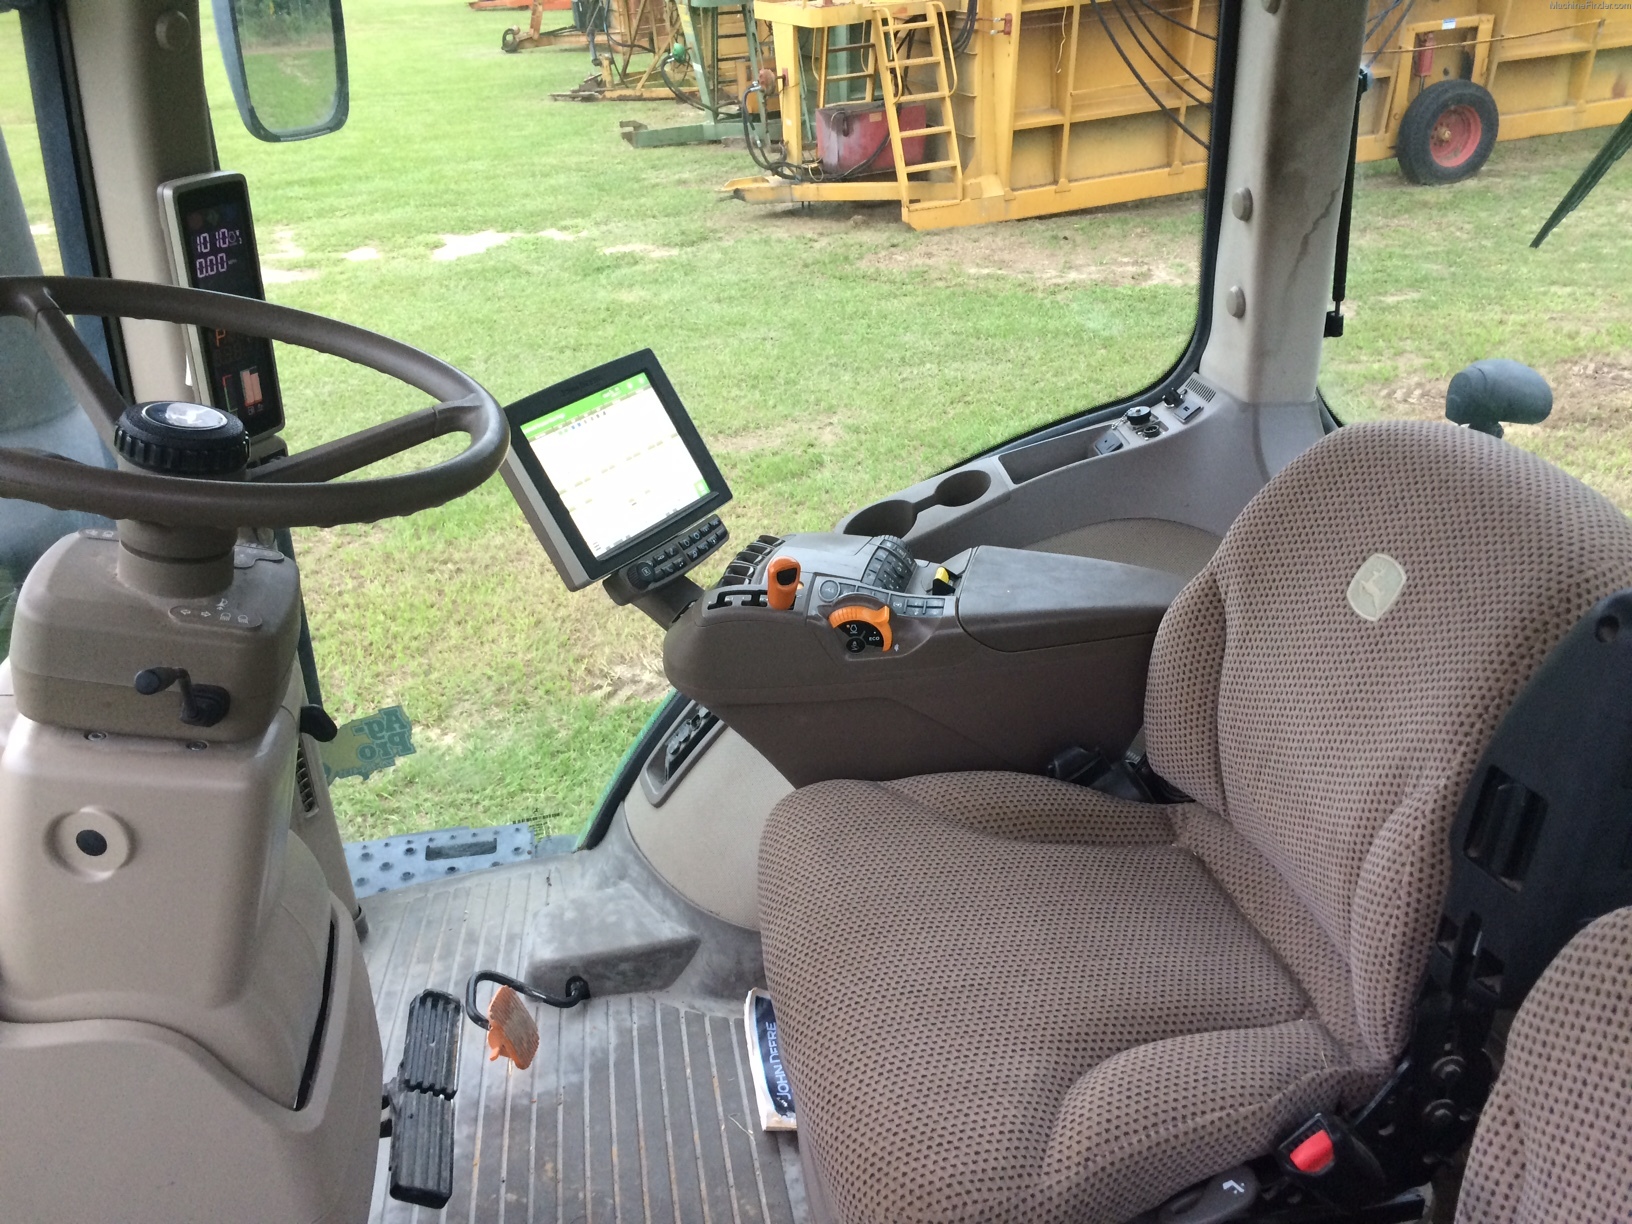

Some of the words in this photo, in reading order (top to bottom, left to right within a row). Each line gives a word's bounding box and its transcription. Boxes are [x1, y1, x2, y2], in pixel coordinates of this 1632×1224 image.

[196, 253, 228, 278] 0.00
[215, 329, 226, 347] P
[774, 1065, 791, 1100] JOHN
